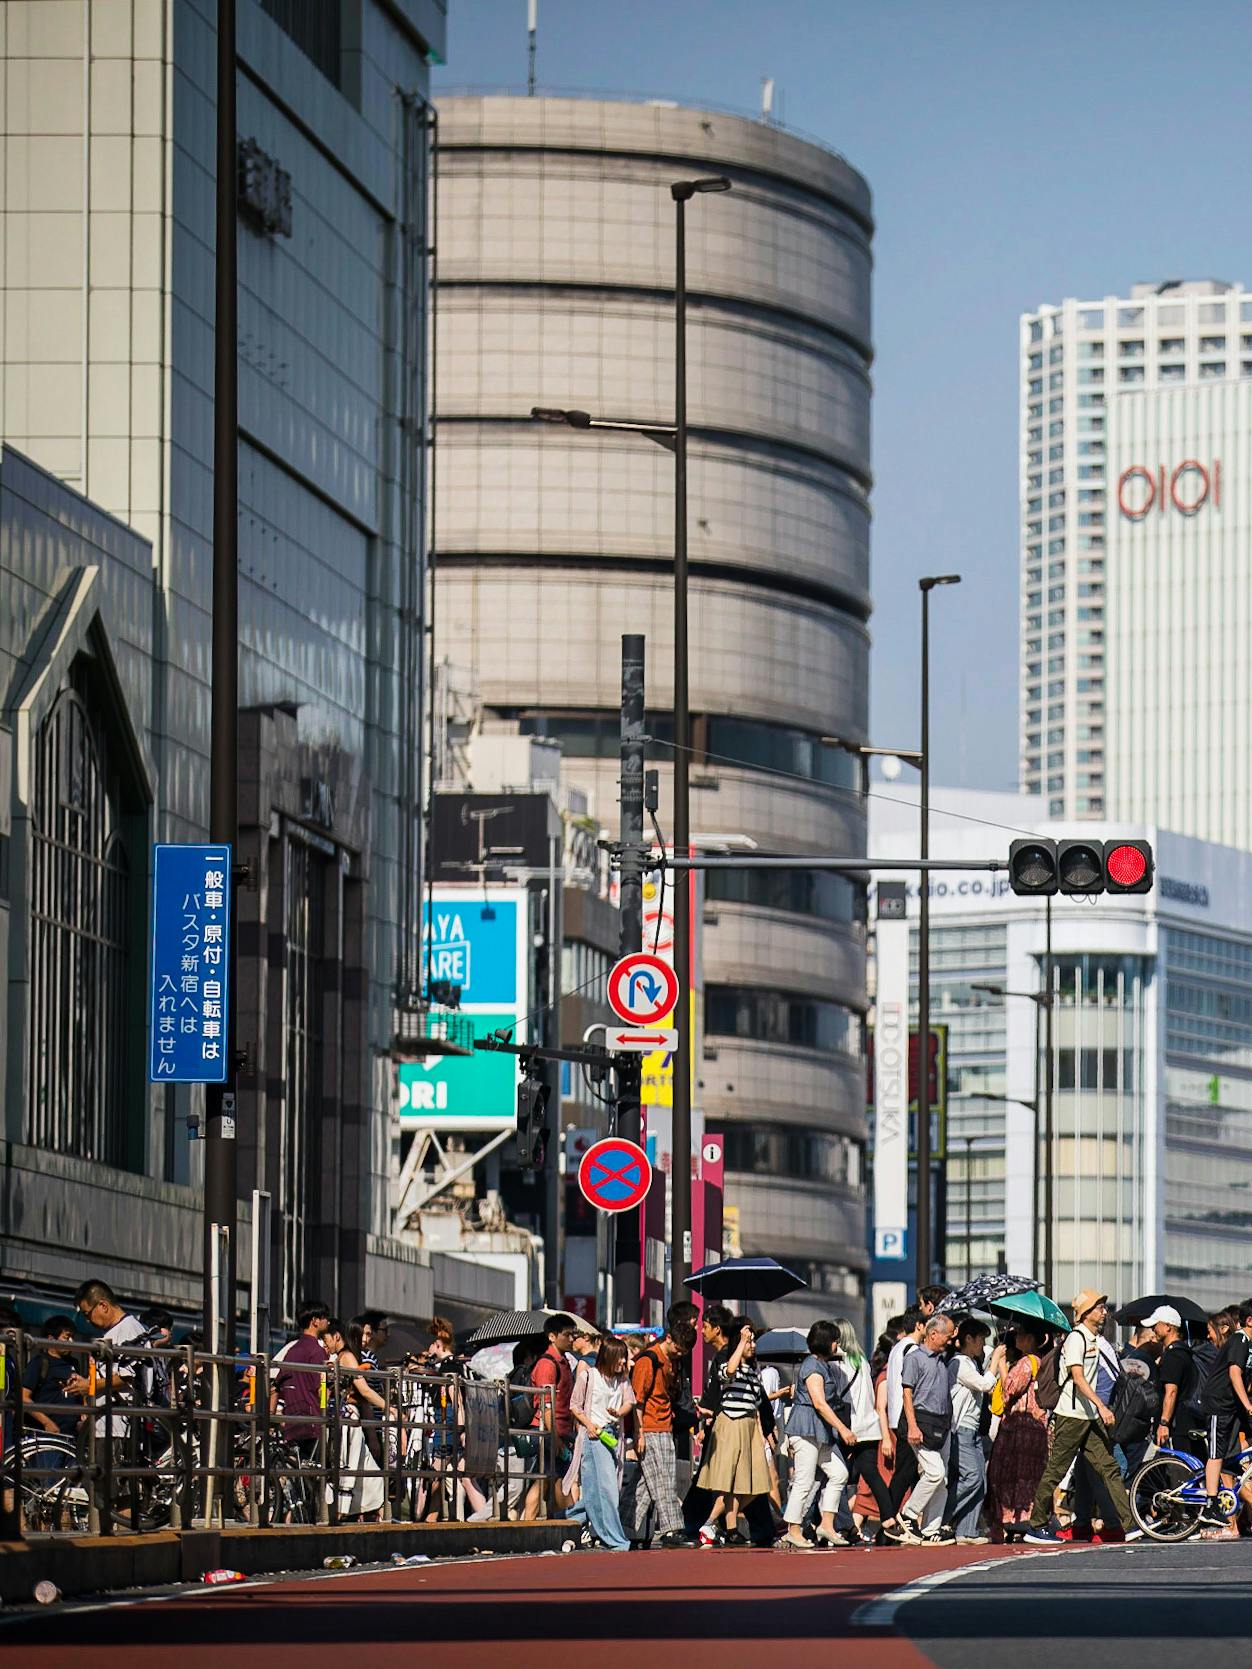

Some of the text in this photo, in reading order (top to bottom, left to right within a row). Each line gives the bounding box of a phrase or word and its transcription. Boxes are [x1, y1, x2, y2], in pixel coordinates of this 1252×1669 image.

[158, 974, 178, 1075] 入れません
[180, 893, 201, 1034] バスタ新宿へは
[202, 855, 224, 1060] 一般車・原付・自転車は
